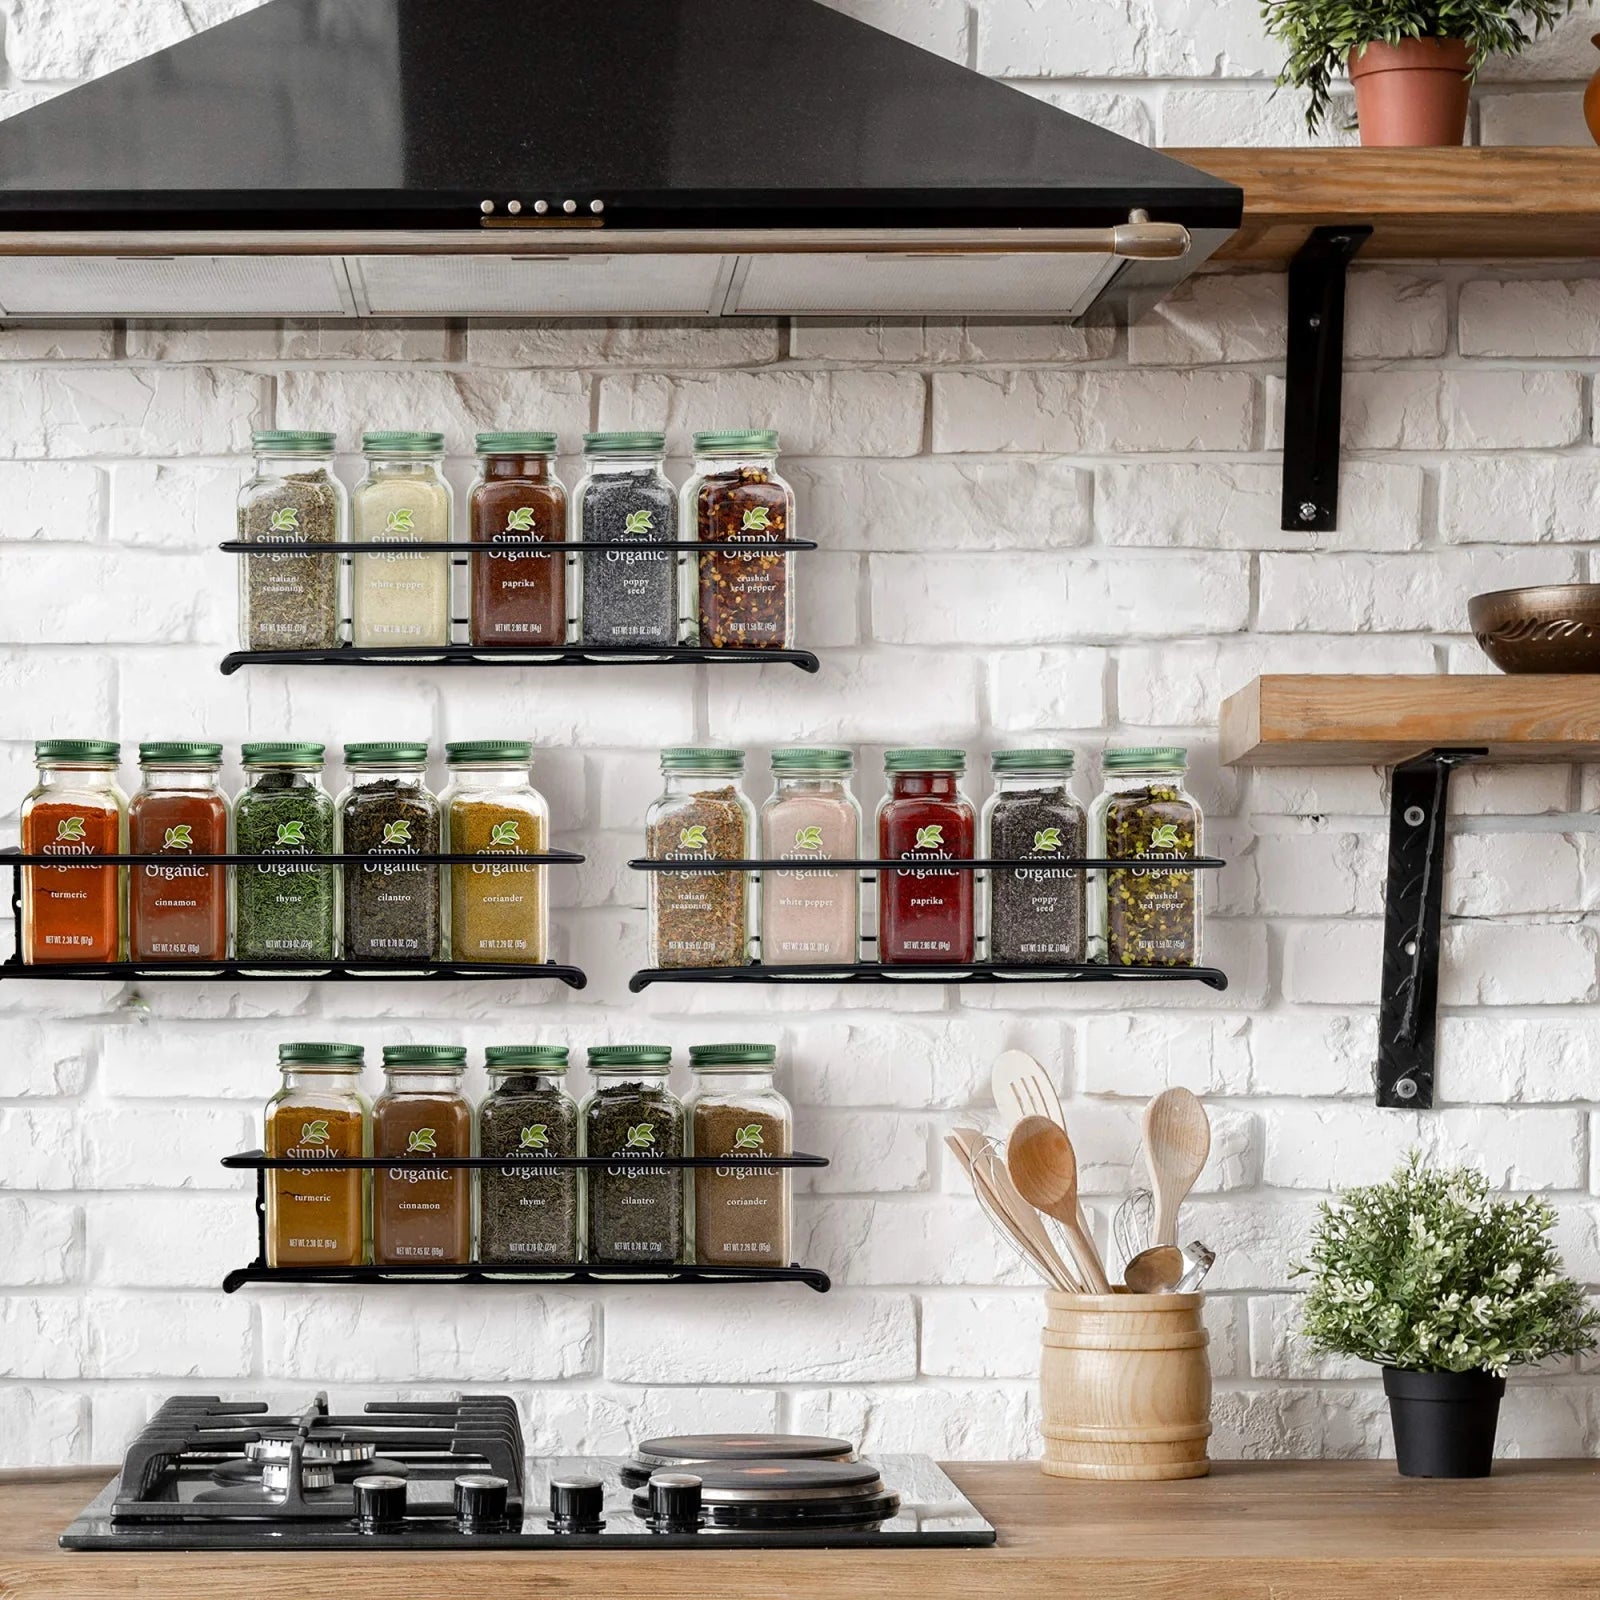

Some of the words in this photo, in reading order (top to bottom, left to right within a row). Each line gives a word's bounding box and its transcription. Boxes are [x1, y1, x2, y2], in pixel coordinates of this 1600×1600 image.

[736, 574, 769, 582] crushed
[502, 579, 535, 589] paprika
[627, 586, 646, 594] seed
[747, 585, 776, 593] pepper
[43, 841, 95, 855] simply
[145, 864, 209, 880] Organic.
[276, 894, 302, 904] thyme
[377, 893, 411, 902] cilantro
[483, 894, 524, 902] coriander
[1145, 891, 1178, 900] crushed
[155, 898, 197, 906] cinnamon
[779, 898, 802, 906] white
[805, 900, 833, 908] pepper
[910, 897, 944, 906] paprika
[1031, 897, 1058, 905] poppy
[1036, 904, 1054, 912] seed
[1156, 903, 1184, 911] pepper
[45, 935, 54, 944] NET
[152, 944, 161, 952] NET
[904, 941, 912, 950] NET
[286, 1145, 339, 1158] simply
[389, 1168, 453, 1183] Organic.
[294, 1194, 331, 1202] turmeric
[519, 1197, 546, 1207] thyme
[621, 1196, 655, 1205] cilantro
[726, 1197, 768, 1206] coriander
[398, 1201, 440, 1209] cinnamon
[289, 1239, 298, 1247] NET
[614, 1242, 623, 1250] NET
[723, 1243, 732, 1251] NET
[396, 1247, 405, 1255] NET
